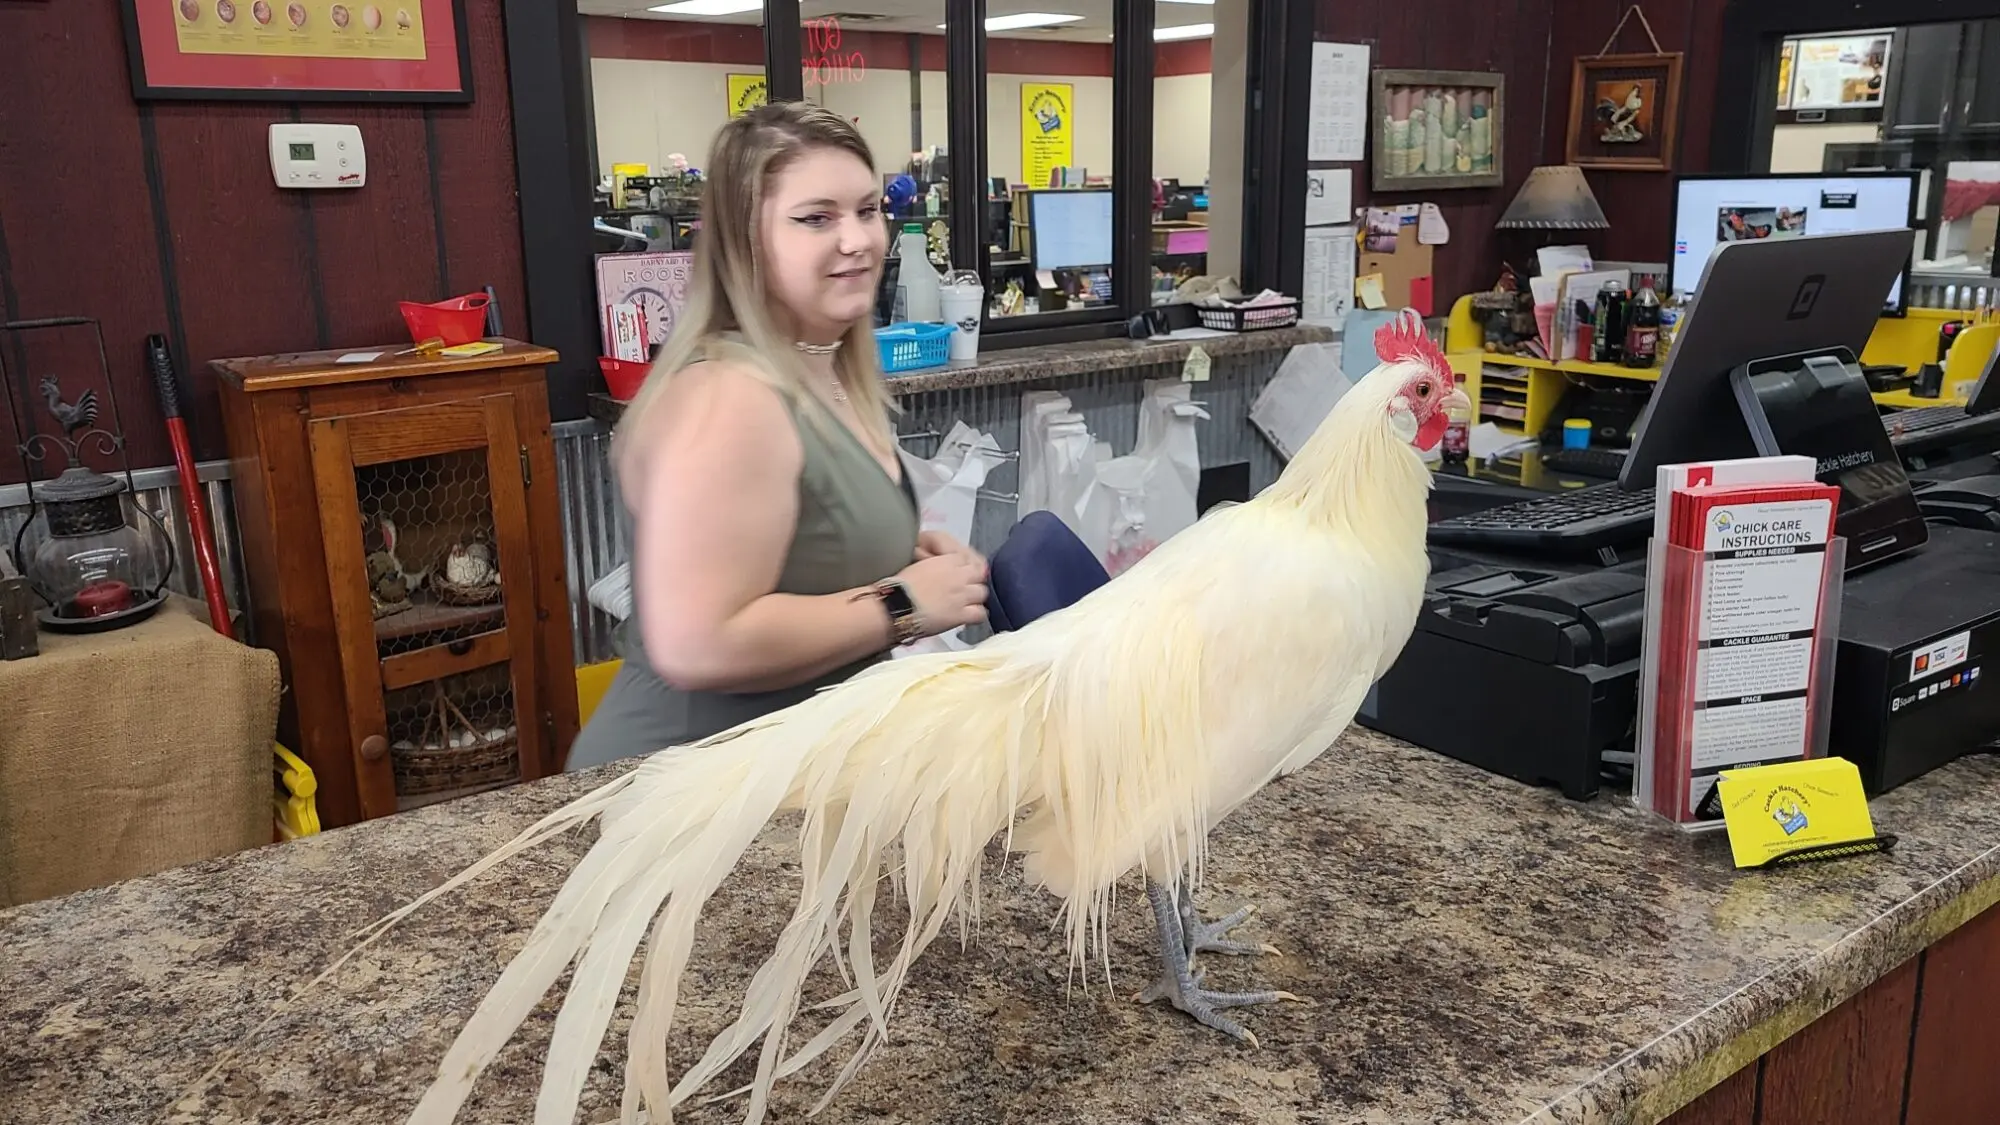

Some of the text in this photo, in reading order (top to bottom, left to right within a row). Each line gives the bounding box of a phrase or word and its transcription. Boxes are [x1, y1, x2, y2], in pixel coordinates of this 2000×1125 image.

[624, 267, 686, 283] ROOS
[1837, 449, 1875, 469] Hatchery
[1734, 519, 1803, 535] CHICK CARE
[1721, 531, 1812, 549] INSTRUCTIONS
[1734, 546, 1796, 559] SUPPLIES NEEDED
[1723, 632, 1791, 647] CACKLE GUARANTEE
[1740, 695, 1763, 705] SPACE
[1899, 694, 1916, 707] Square
[1764, 788, 1779, 813] Cackle
